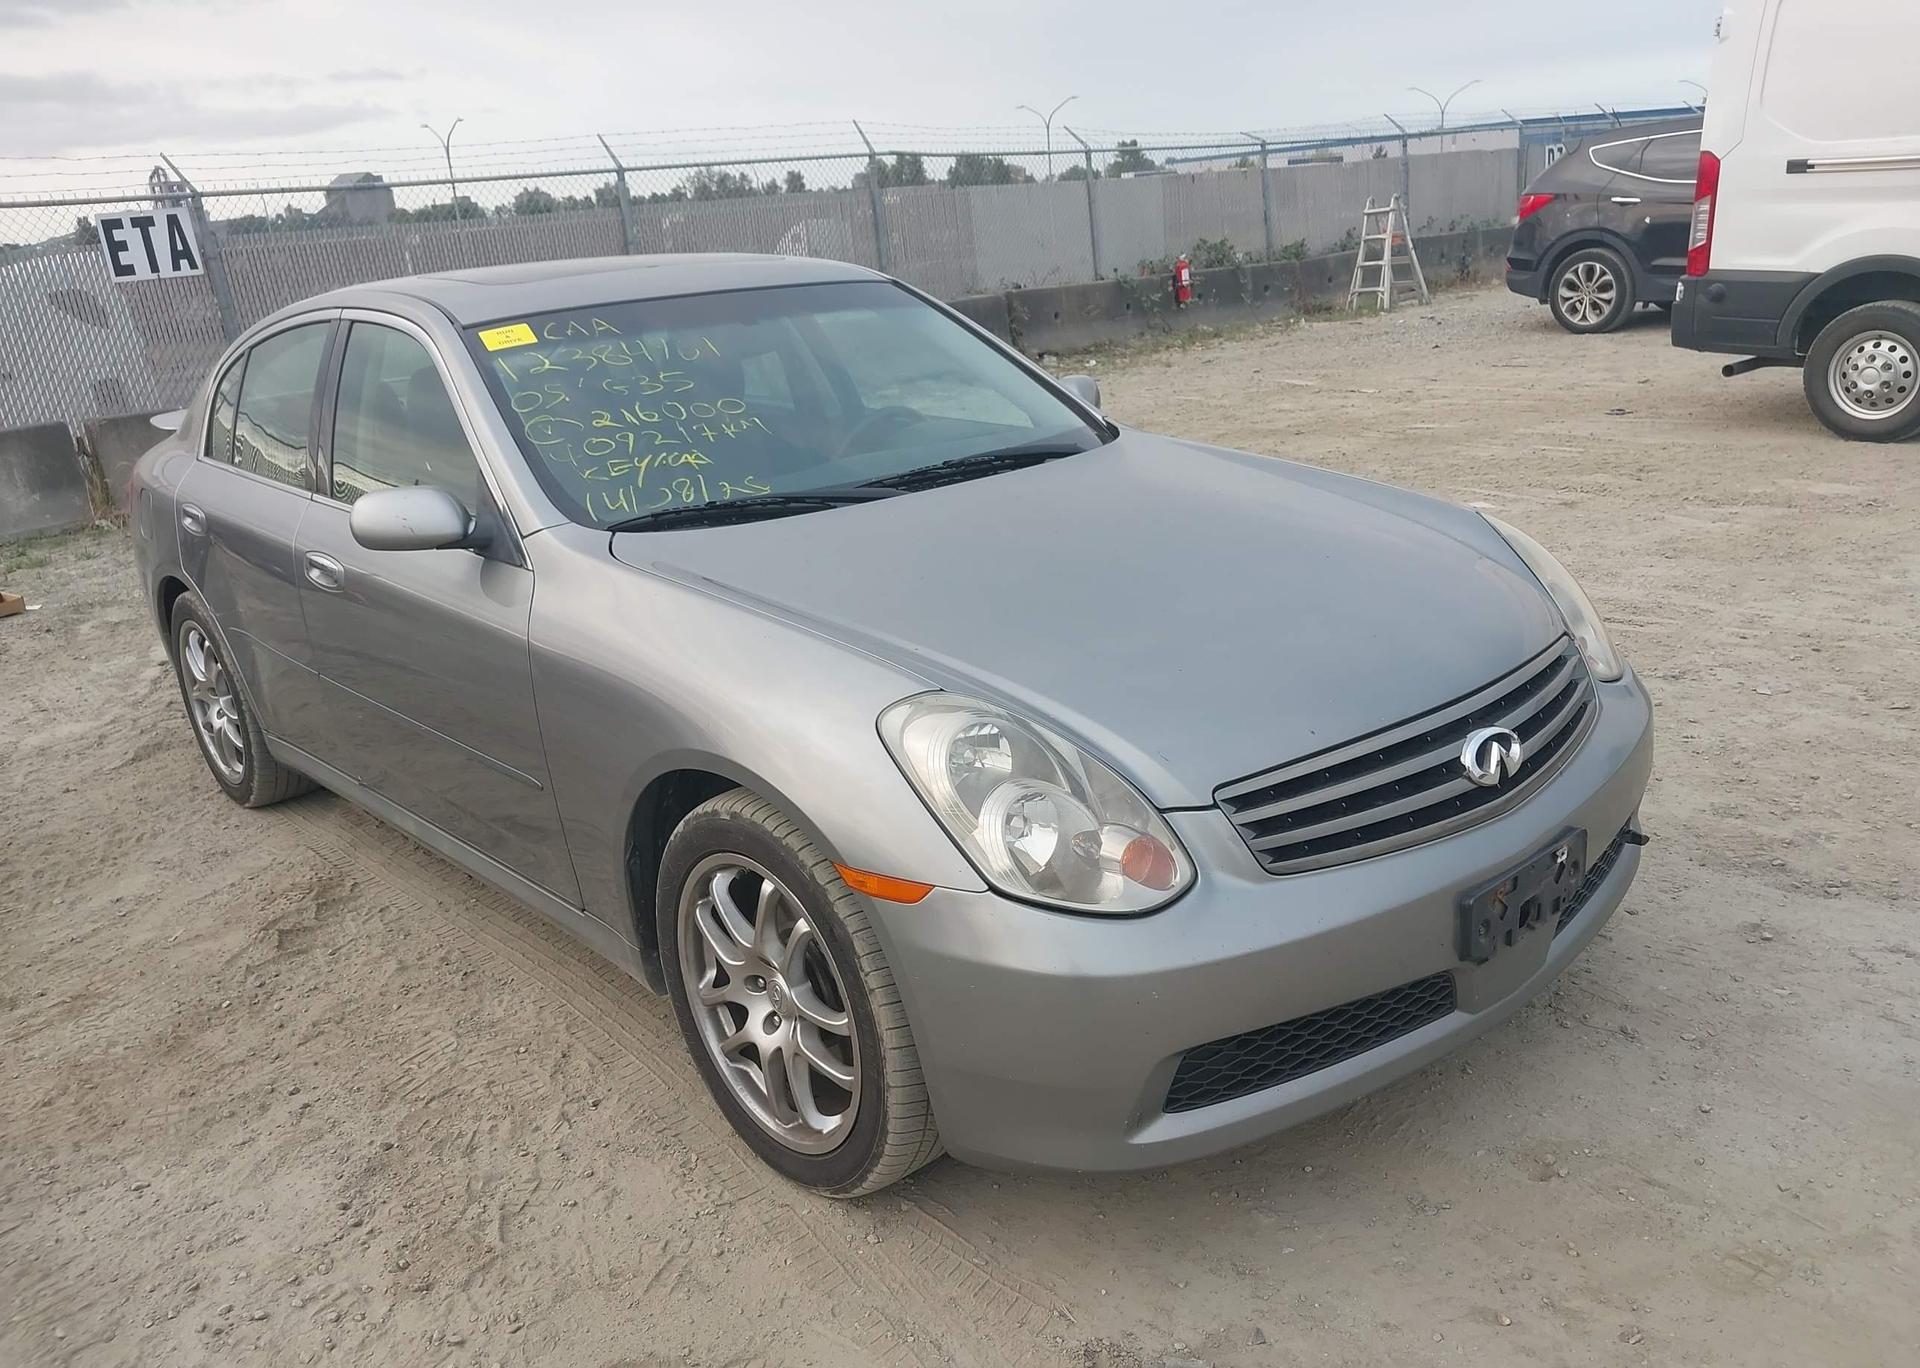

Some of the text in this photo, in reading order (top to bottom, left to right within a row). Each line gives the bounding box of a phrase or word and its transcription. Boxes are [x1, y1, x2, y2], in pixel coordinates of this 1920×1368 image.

[100, 213, 199, 278] ETA
[543, 317, 623, 340] CAA
[602, 371, 695, 397] G35
